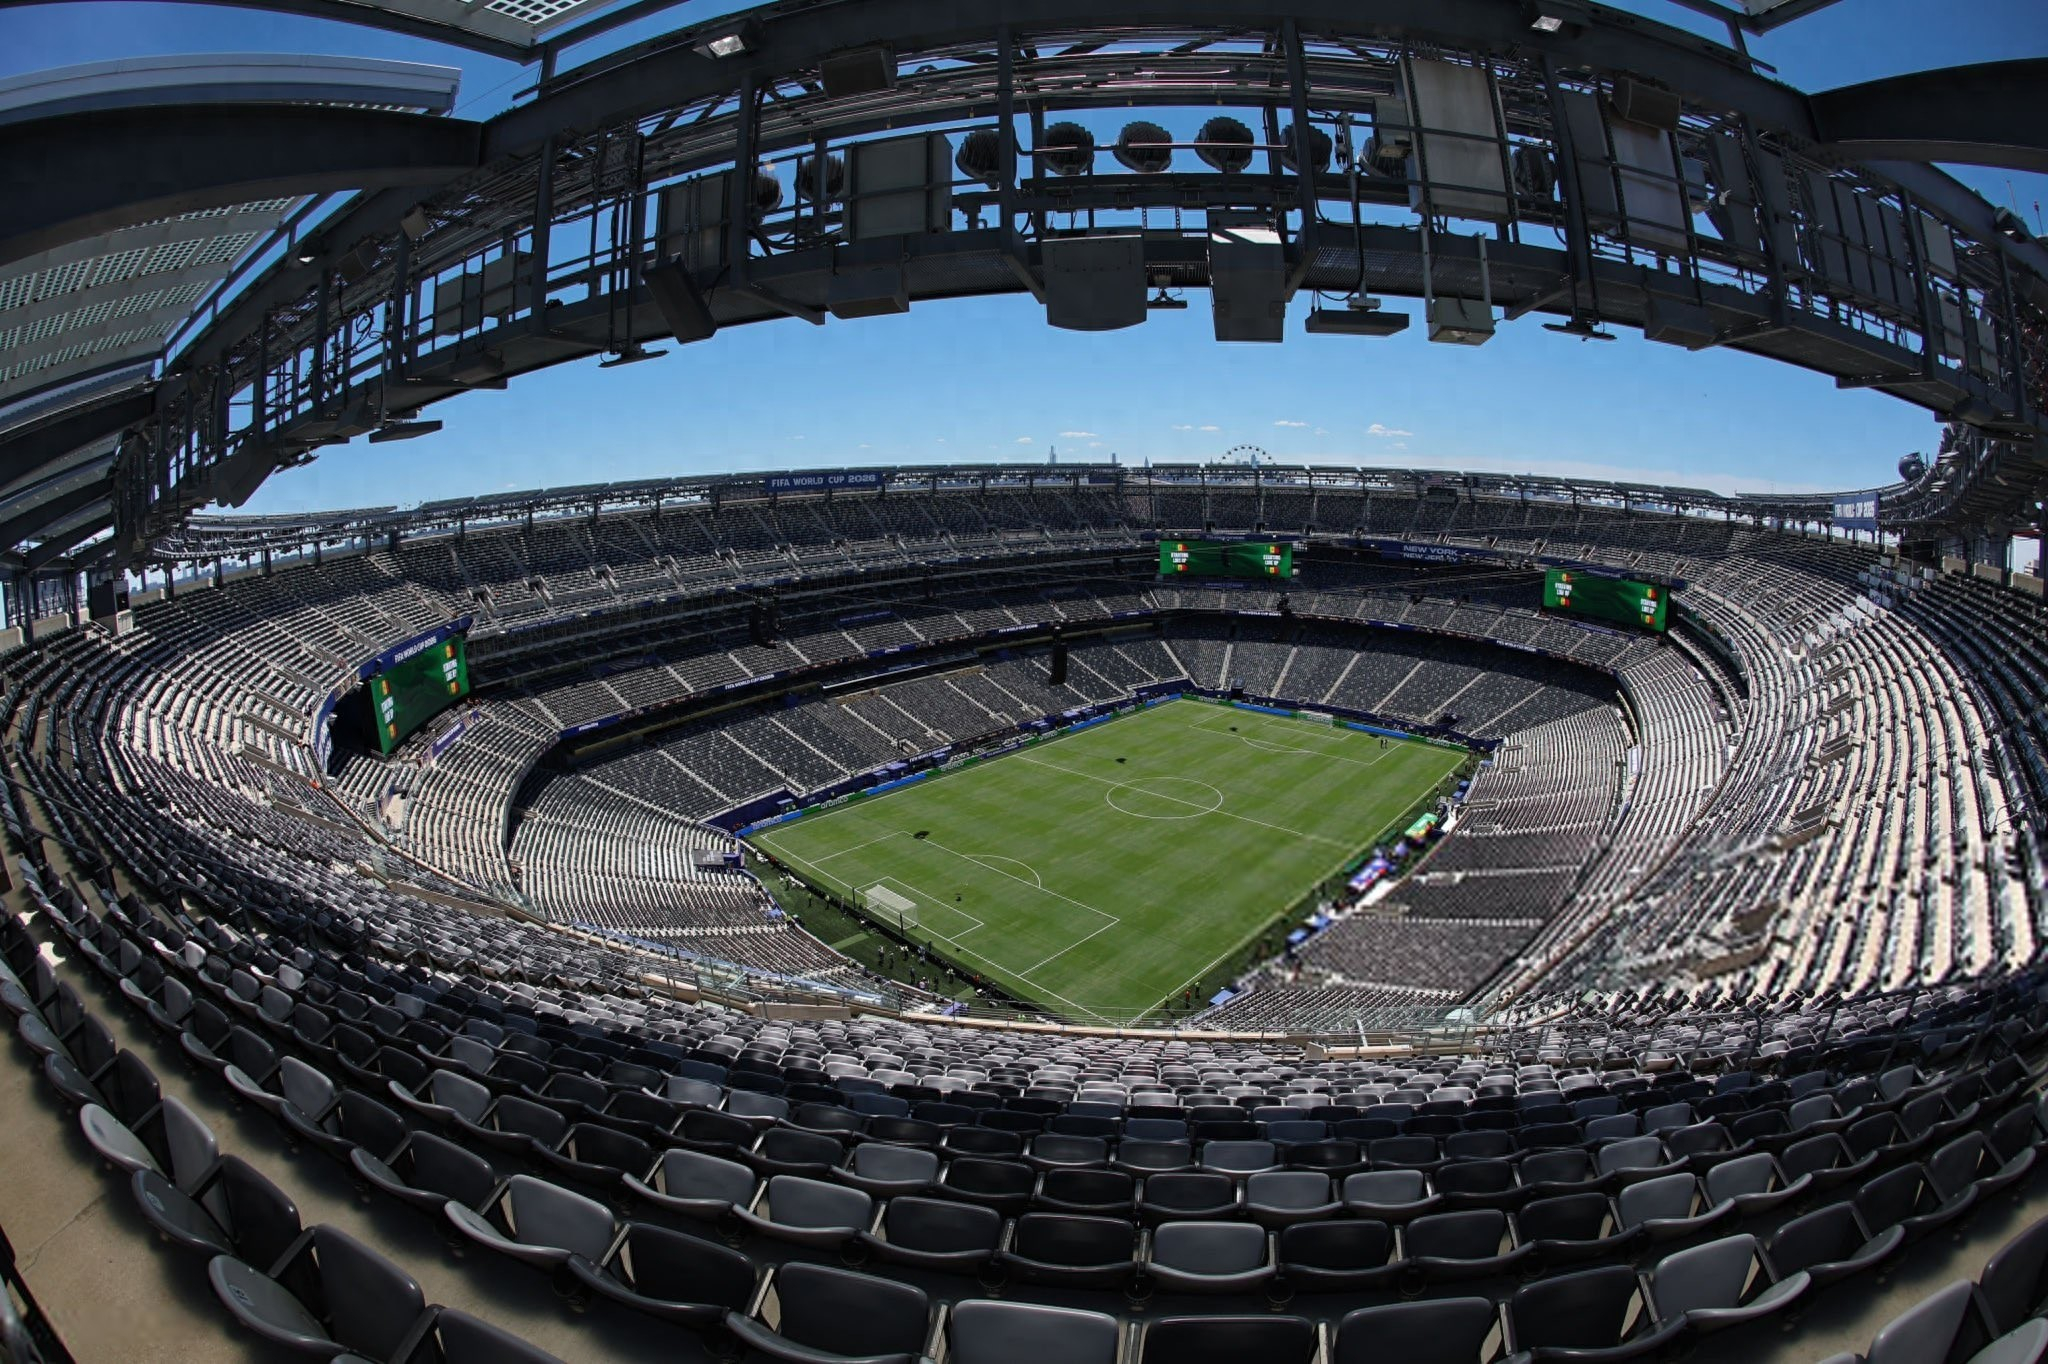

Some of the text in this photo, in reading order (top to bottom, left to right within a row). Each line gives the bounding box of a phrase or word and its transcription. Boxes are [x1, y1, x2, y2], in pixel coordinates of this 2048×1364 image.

[772, 474, 876, 488] FIFA WORLD CUP 2026
[1403, 545, 1458, 556] NEW YORK
[1424, 554, 1458, 562] JERY
[735, 680, 751, 688] WORLD
[821, 796, 849, 809] aramco
